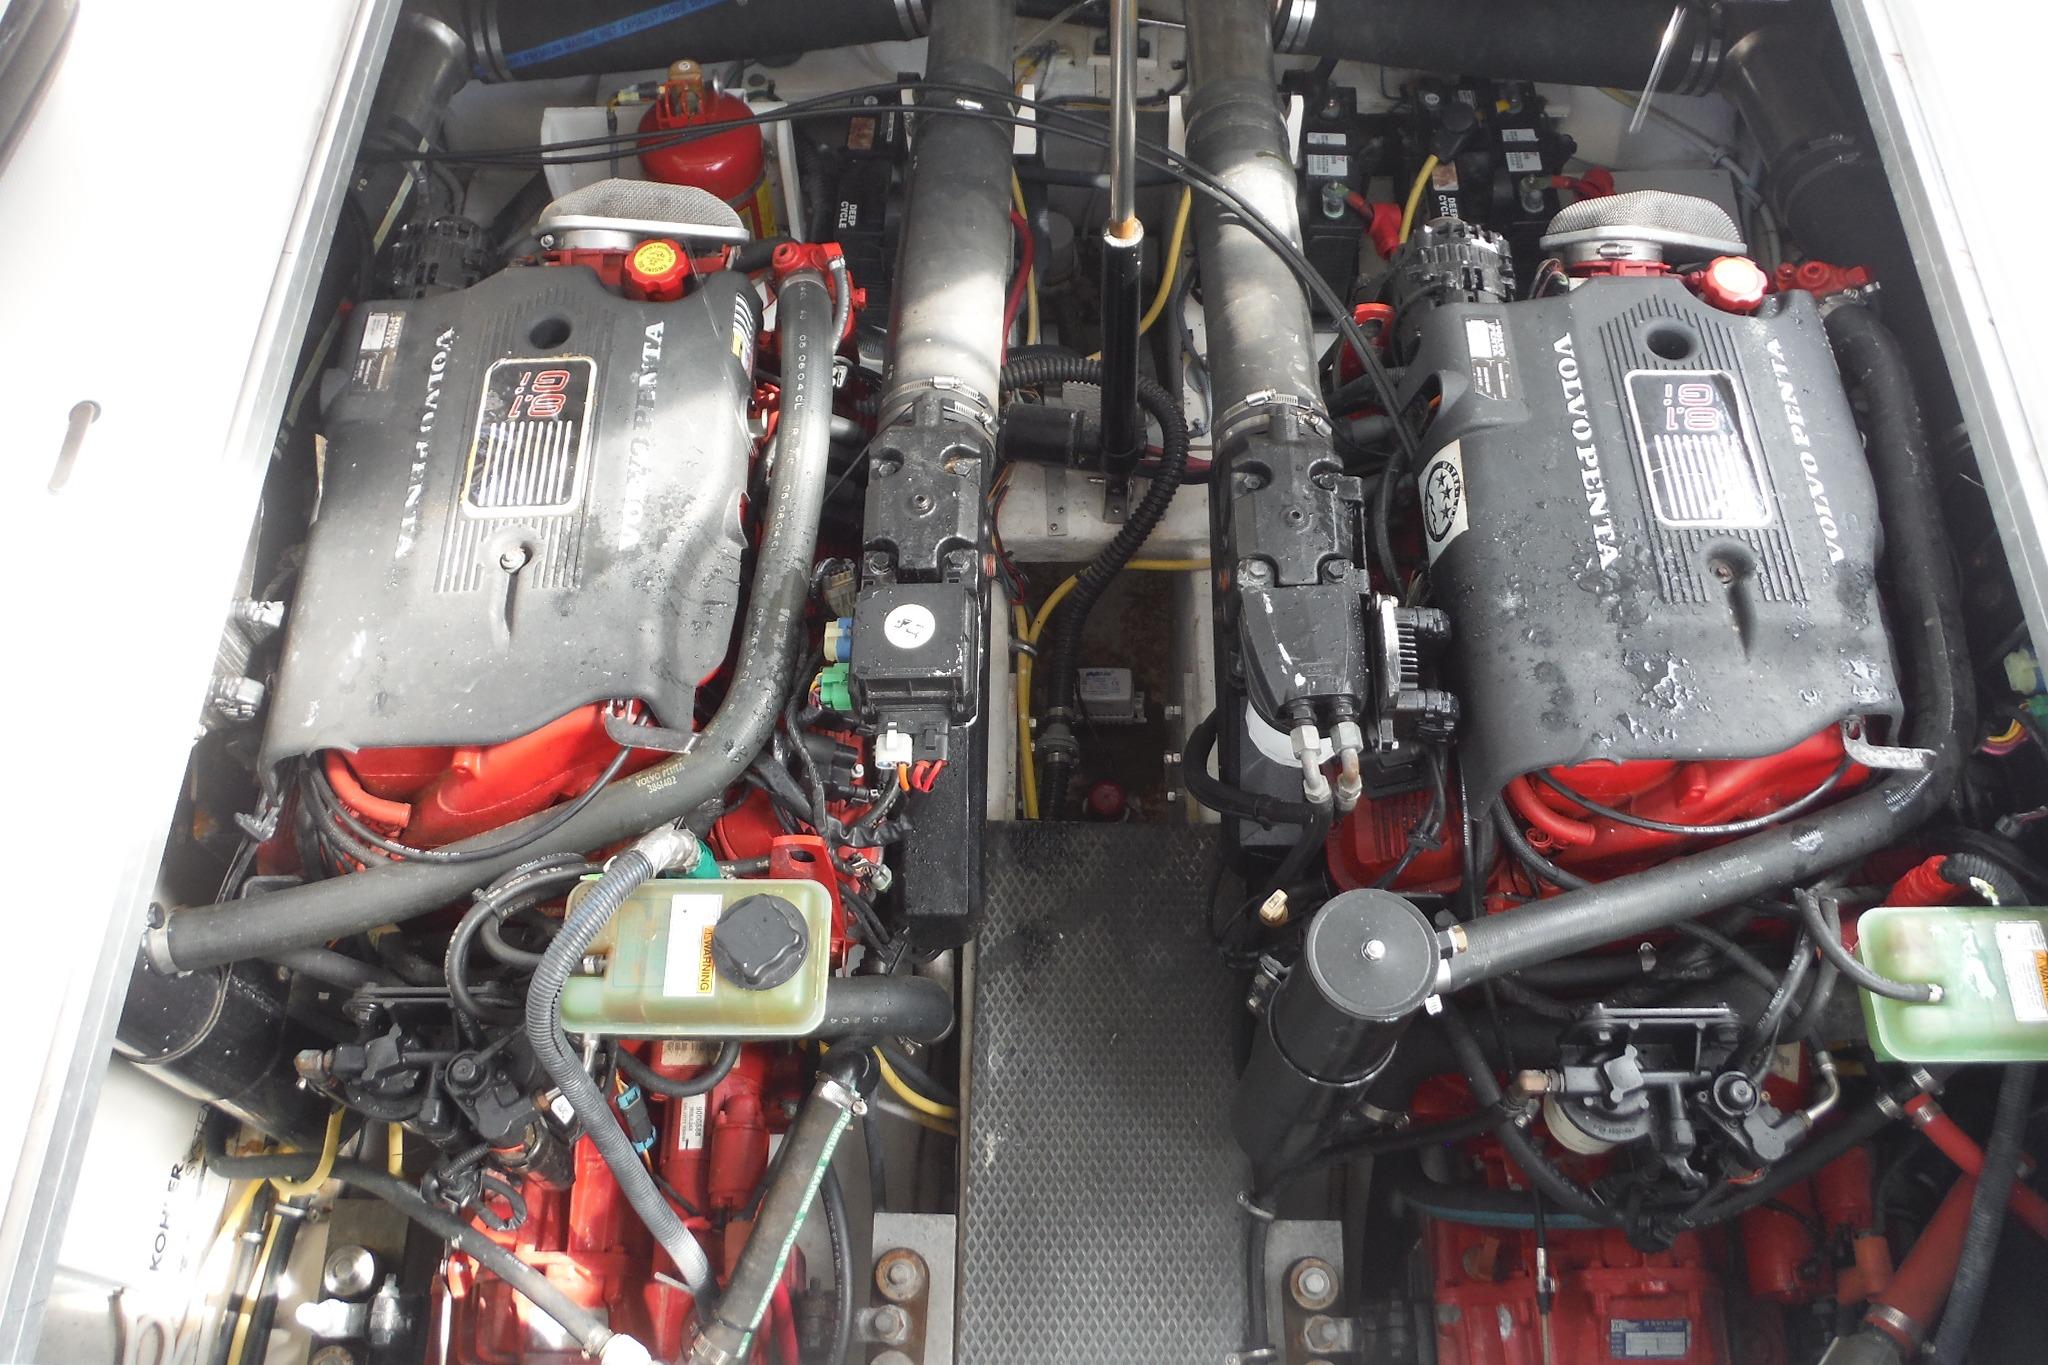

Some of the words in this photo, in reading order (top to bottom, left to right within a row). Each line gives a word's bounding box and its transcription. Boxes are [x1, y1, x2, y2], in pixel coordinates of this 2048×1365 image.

[839, 201, 849, 228] CYCLE
[848, 204, 857, 226] DEEP
[1438, 195, 1449, 217] CYCL
[508, 393, 567, 418] 8.1
[1767, 338, 1811, 448] PENTA
[1666, 406, 1720, 431] 8.1
[1553, 332, 1593, 441] VOLVO
[1576, 444, 1619, 570] PENTA
[618, 437, 651, 551] VOVO
[1800, 451, 1845, 566] VOLVO
[635, 771, 661, 788] VOLVO
[662, 762, 686, 778] PENTA
[700, 939, 713, 991] WARNING
[822, 1111, 852, 1161] REMIUM
[799, 1165, 827, 1213] MARINE
[149, 1163, 185, 1272] KOHER
[778, 1218, 804, 1263] WATER
